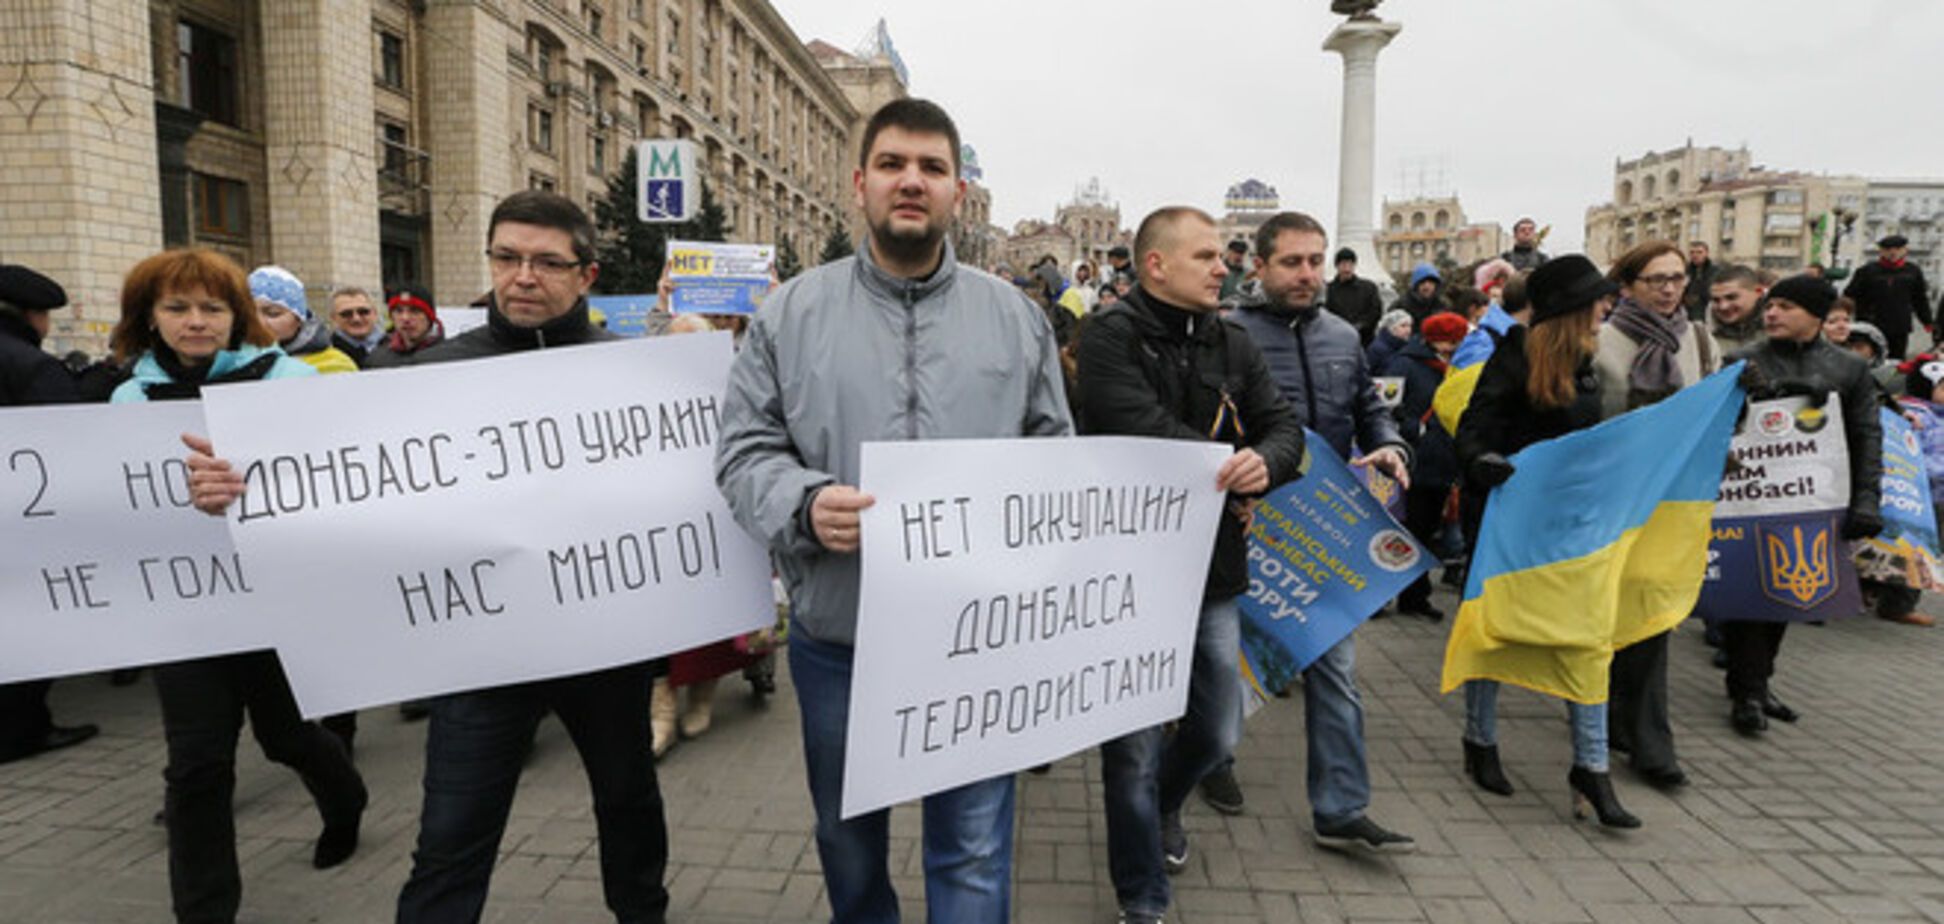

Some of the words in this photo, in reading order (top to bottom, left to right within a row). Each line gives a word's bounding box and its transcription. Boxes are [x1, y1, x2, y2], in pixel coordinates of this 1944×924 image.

[674, 255, 711, 270] НЕТ
[9, 448, 56, 518] 2
[900, 496, 972, 562] НЕТ
[1004, 485, 1189, 549] ОККУПАЦИИ
[41, 563, 111, 611] НЕ
[397, 559, 505, 626] НАС
[547, 511, 722, 605] МНОГО!
[1247, 541, 1320, 605] РОТИ
[946, 573, 1137, 659] ДОНБАССА
[894, 648, 1178, 758] ТЕРРОРИСТАМИ
